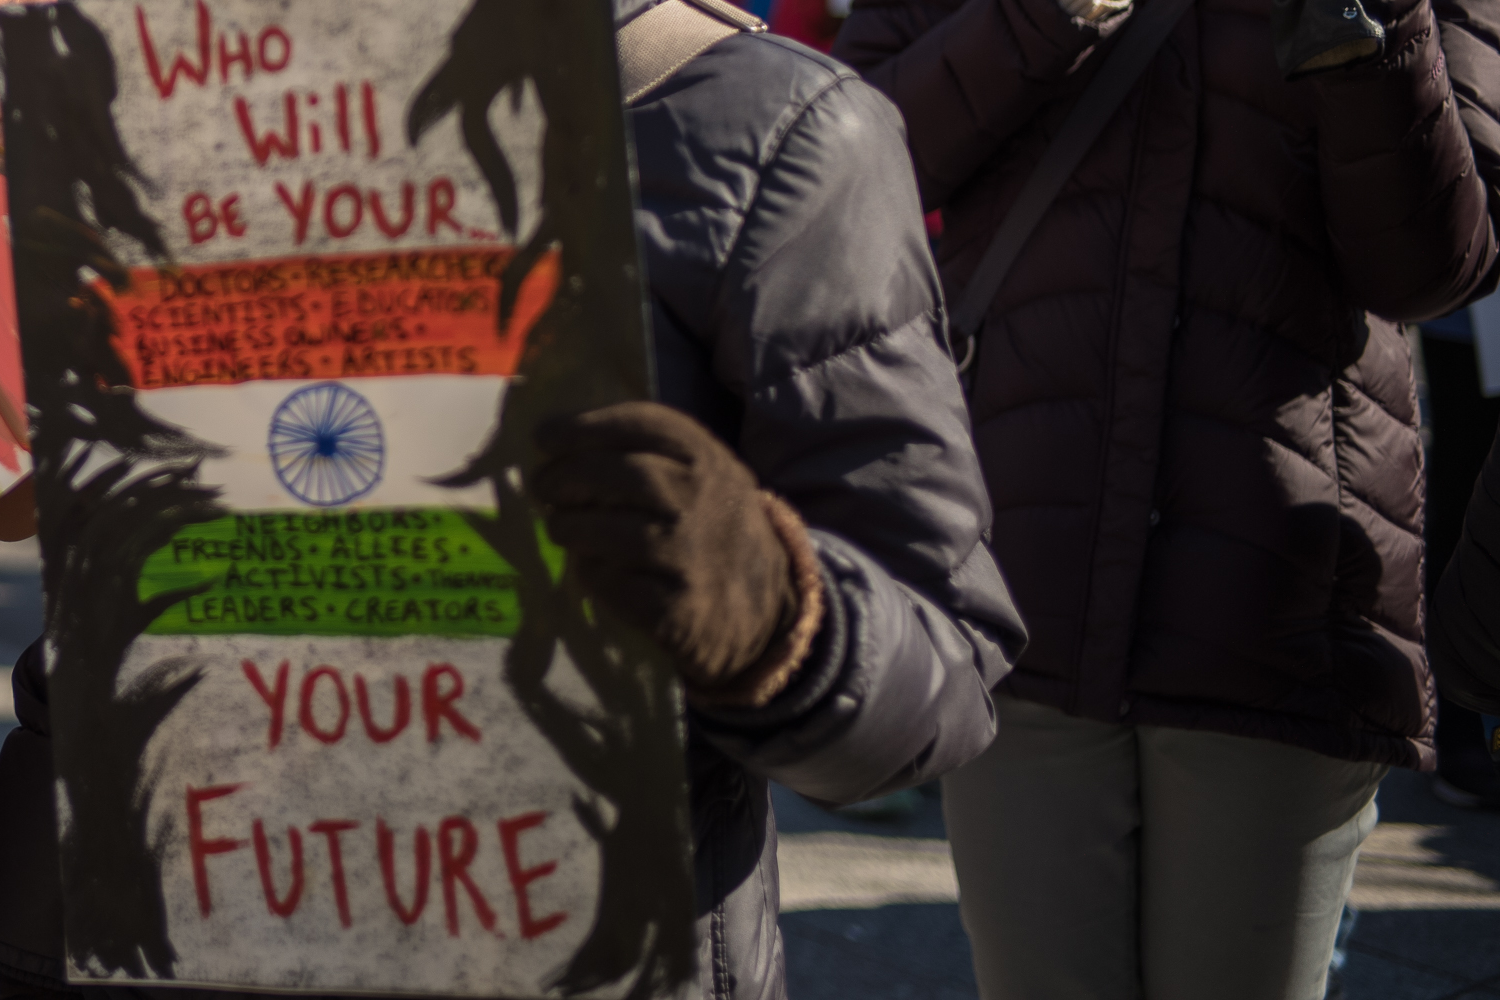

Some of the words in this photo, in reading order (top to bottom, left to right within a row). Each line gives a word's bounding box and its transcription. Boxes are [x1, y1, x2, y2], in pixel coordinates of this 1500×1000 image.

[235, 80, 379, 168] Will
[182, 190, 248, 246] BE
[160, 263, 288, 301] DOCTORS
[129, 296, 304, 330] SCIENTISTS
[136, 324, 276, 357] BUSINESS
[284, 318, 408, 347] OWNERS
[140, 352, 315, 386] ENGINEERS
[342, 345, 478, 375] ARTISTS
[235, 511, 431, 537] NEIGHBORS
[172, 536, 301, 564] FRIENDS
[331, 534, 450, 563] ALLIES
[225, 562, 407, 591] ACTIVISTS
[185, 596, 318, 624] LEADERS
[345, 596, 505, 624] CREATORS
[242, 658, 482, 751] YOUR
[186, 781, 569, 940] FUTURE
